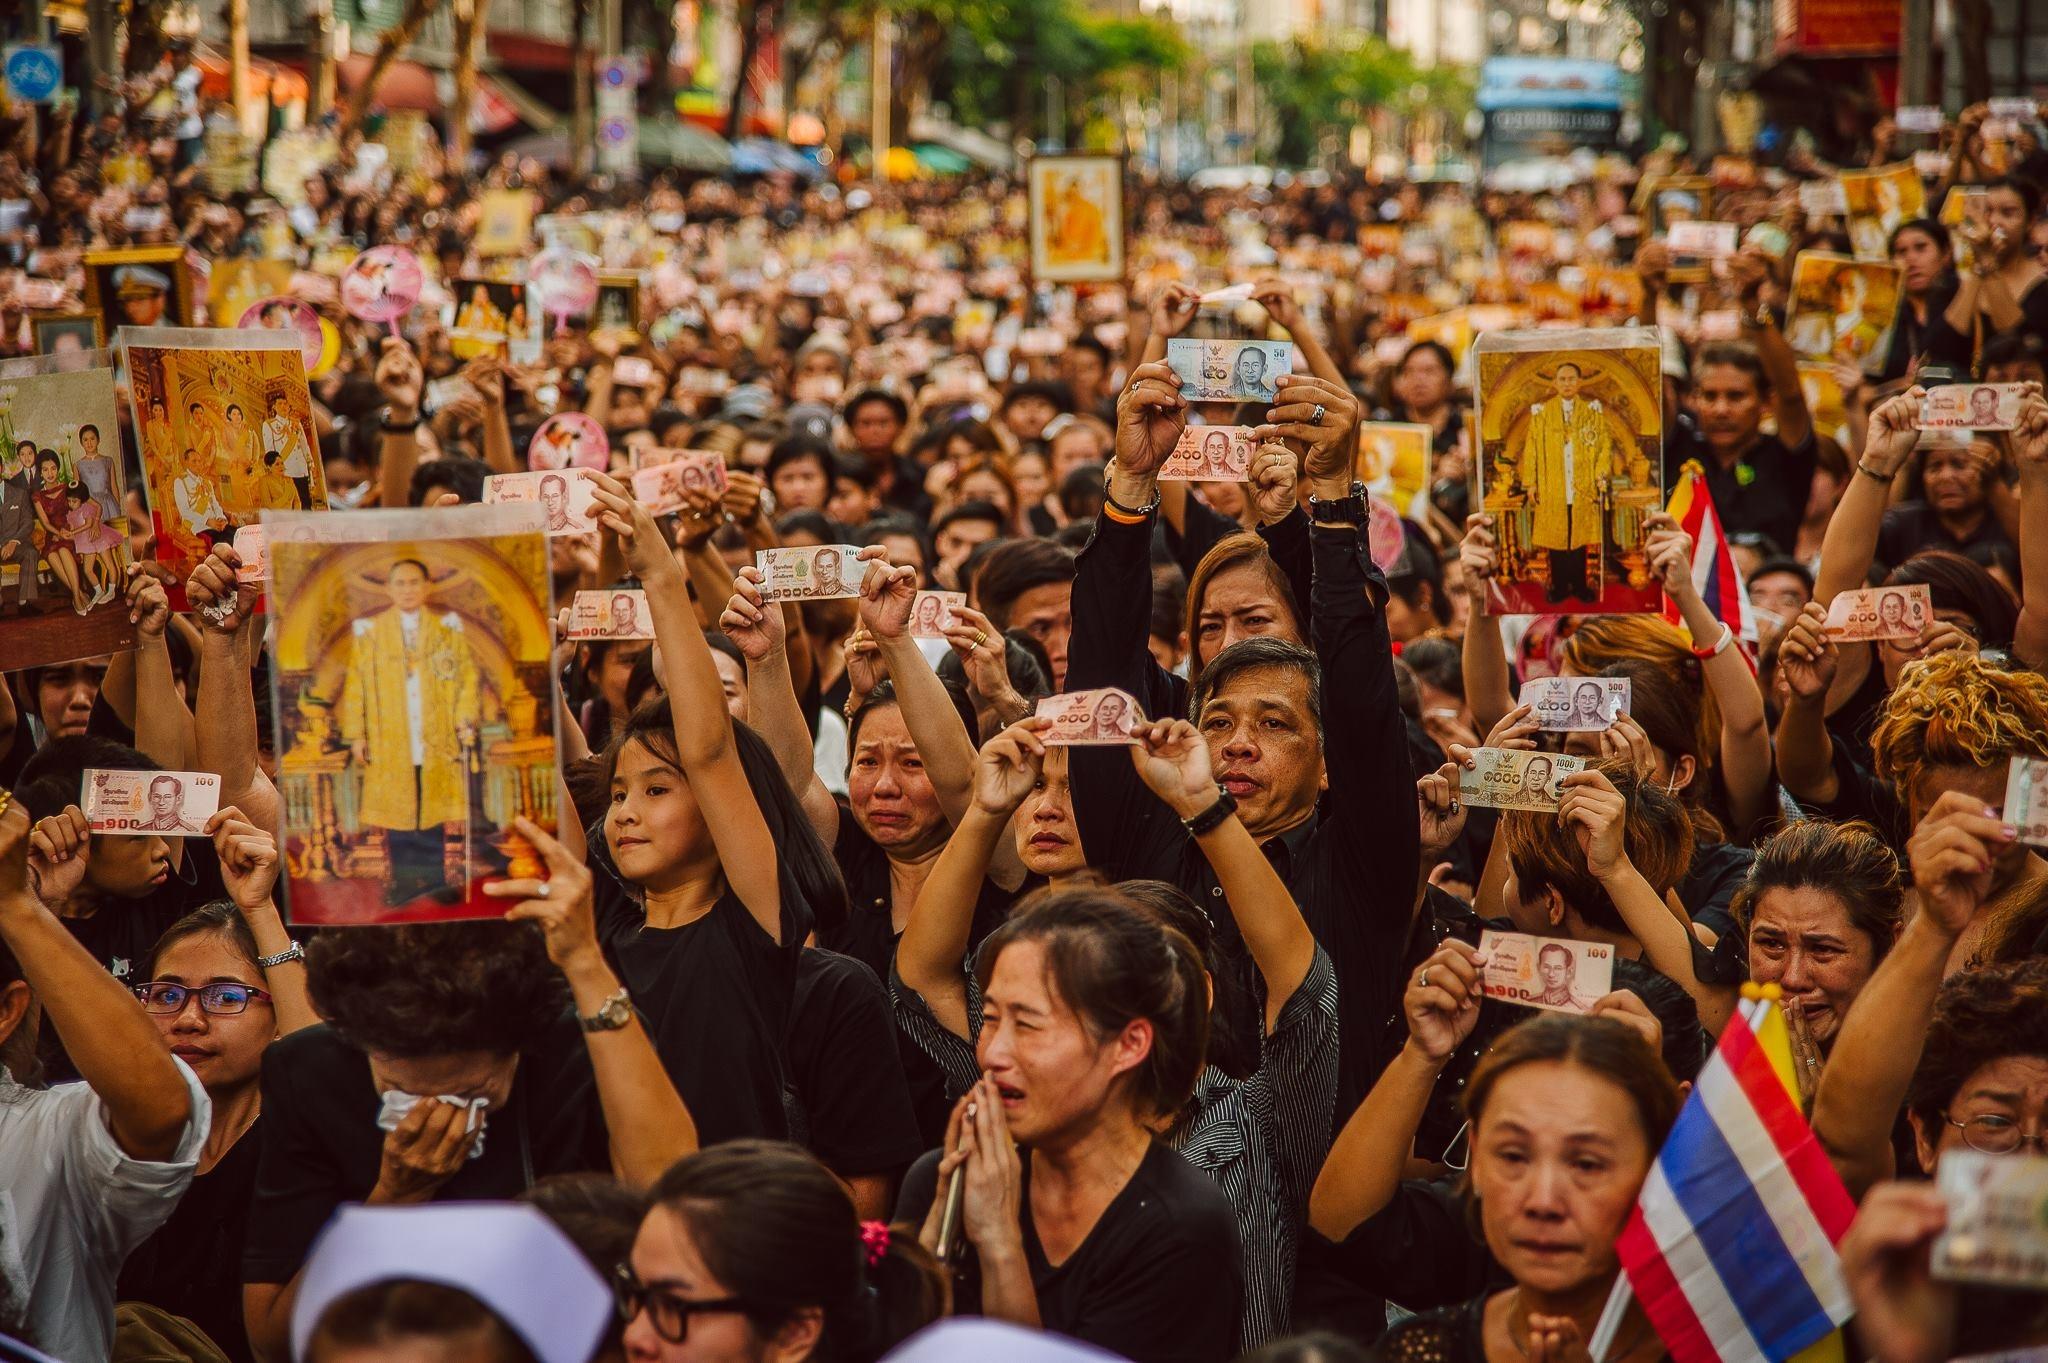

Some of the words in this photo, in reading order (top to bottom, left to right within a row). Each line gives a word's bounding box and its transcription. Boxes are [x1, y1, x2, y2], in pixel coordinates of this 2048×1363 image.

[1273, 348, 1285, 358] 50
[1234, 432, 1247, 441] 100
[1172, 450, 1201, 461] ๑๐๐
[1608, 683, 1623, 691] 500
[1057, 713, 1090, 723] ๑๐๐
[1556, 758, 1576, 769] 1000
[194, 777, 214, 786] 100
[1587, 947, 1608, 959] 100
